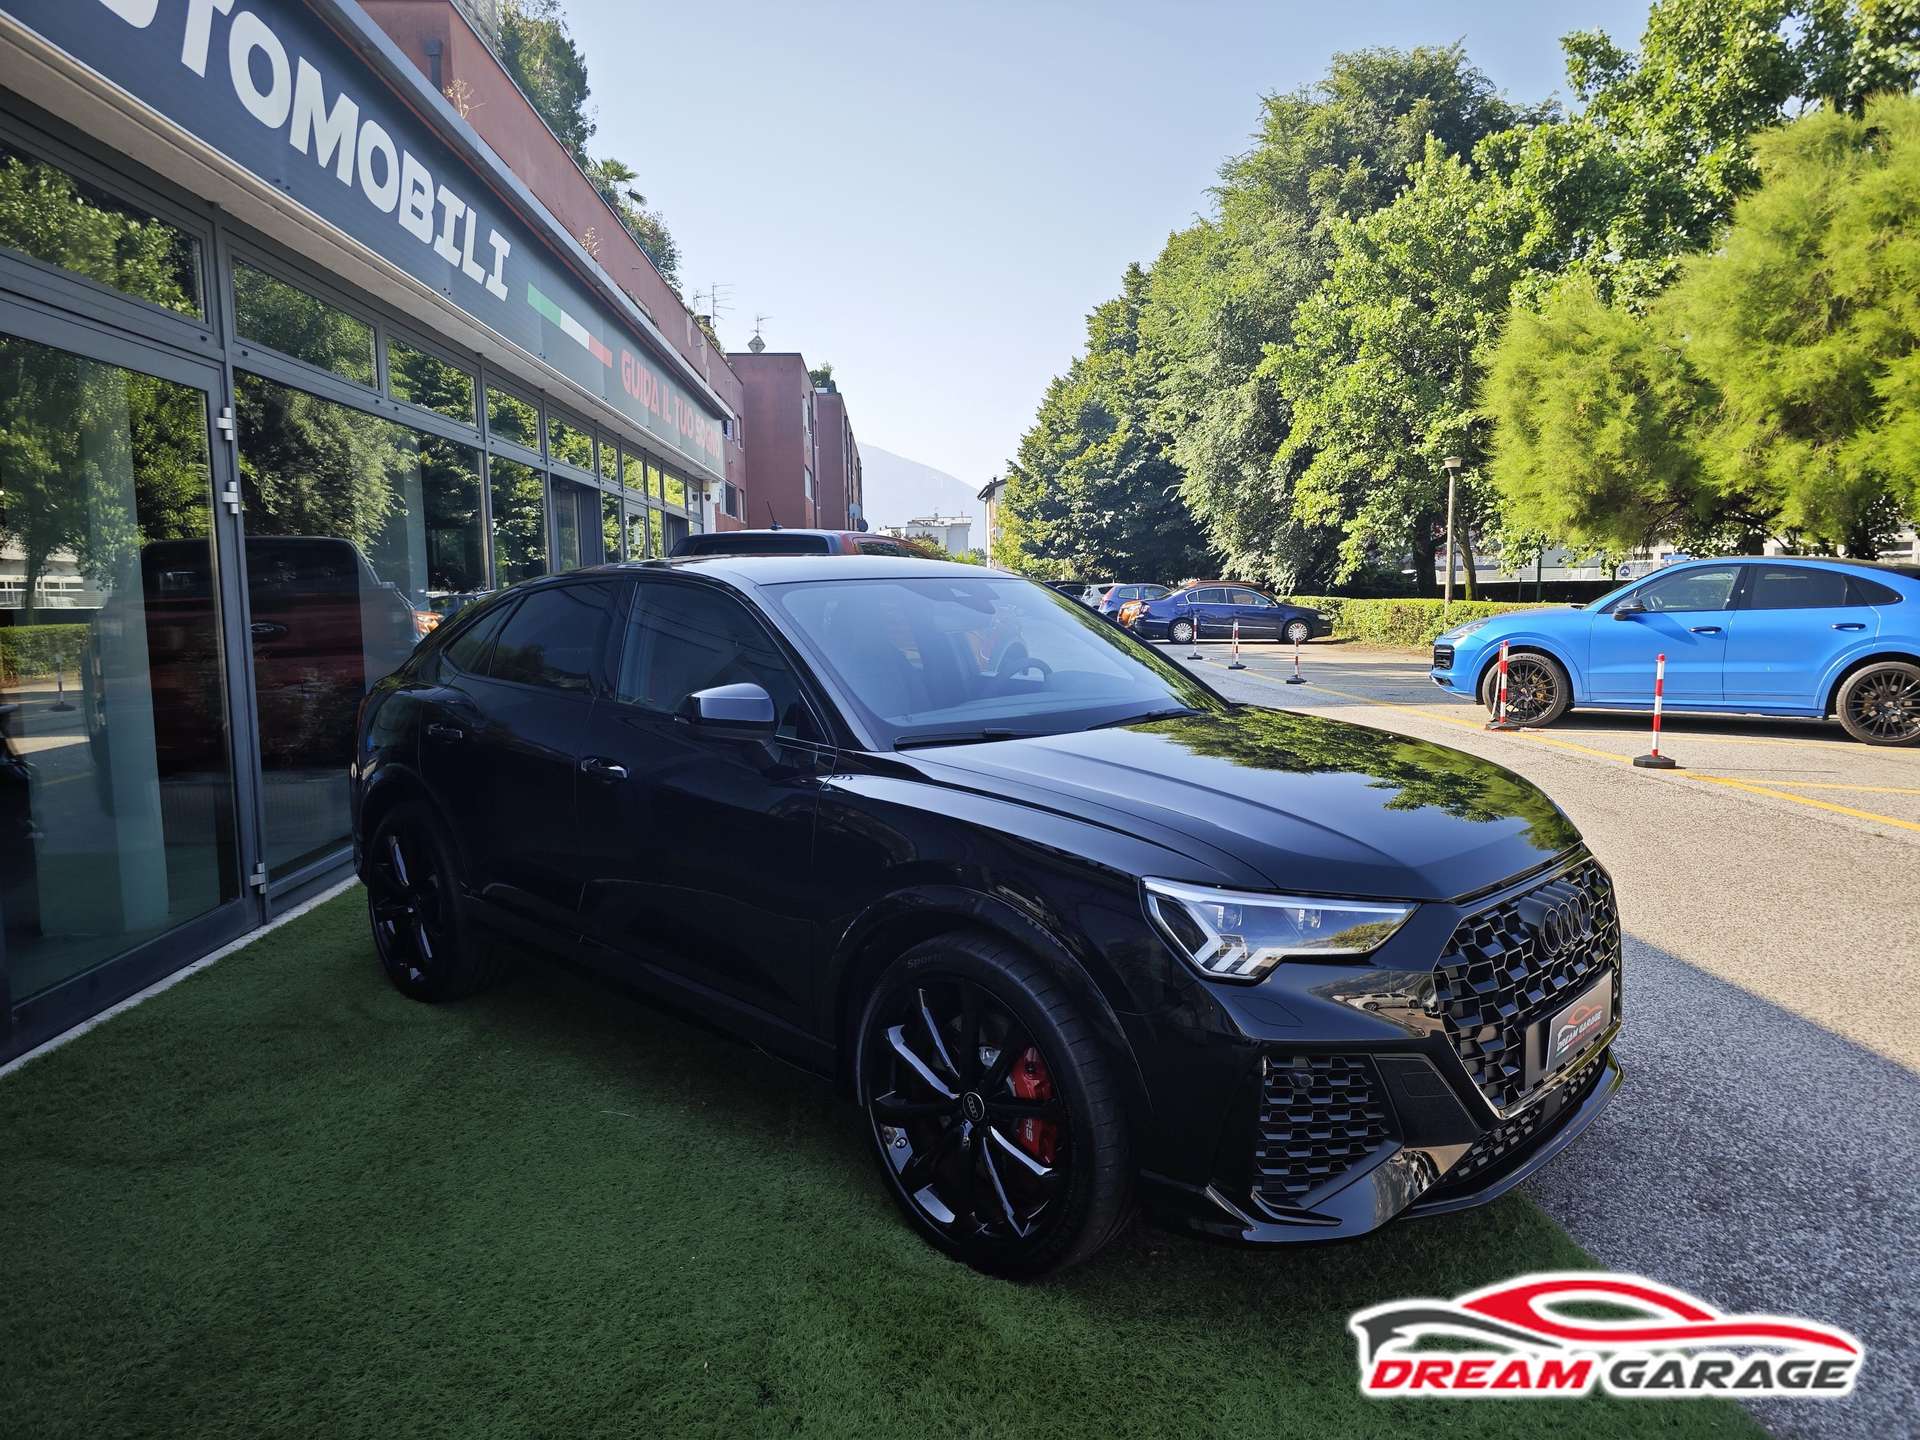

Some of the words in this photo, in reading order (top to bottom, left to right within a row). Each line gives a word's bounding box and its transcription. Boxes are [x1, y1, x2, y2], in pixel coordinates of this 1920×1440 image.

[106, 0, 511, 302] TOMOBILI
[621, 351, 659, 416] GUIDA
[673, 394, 695, 439] TUO
